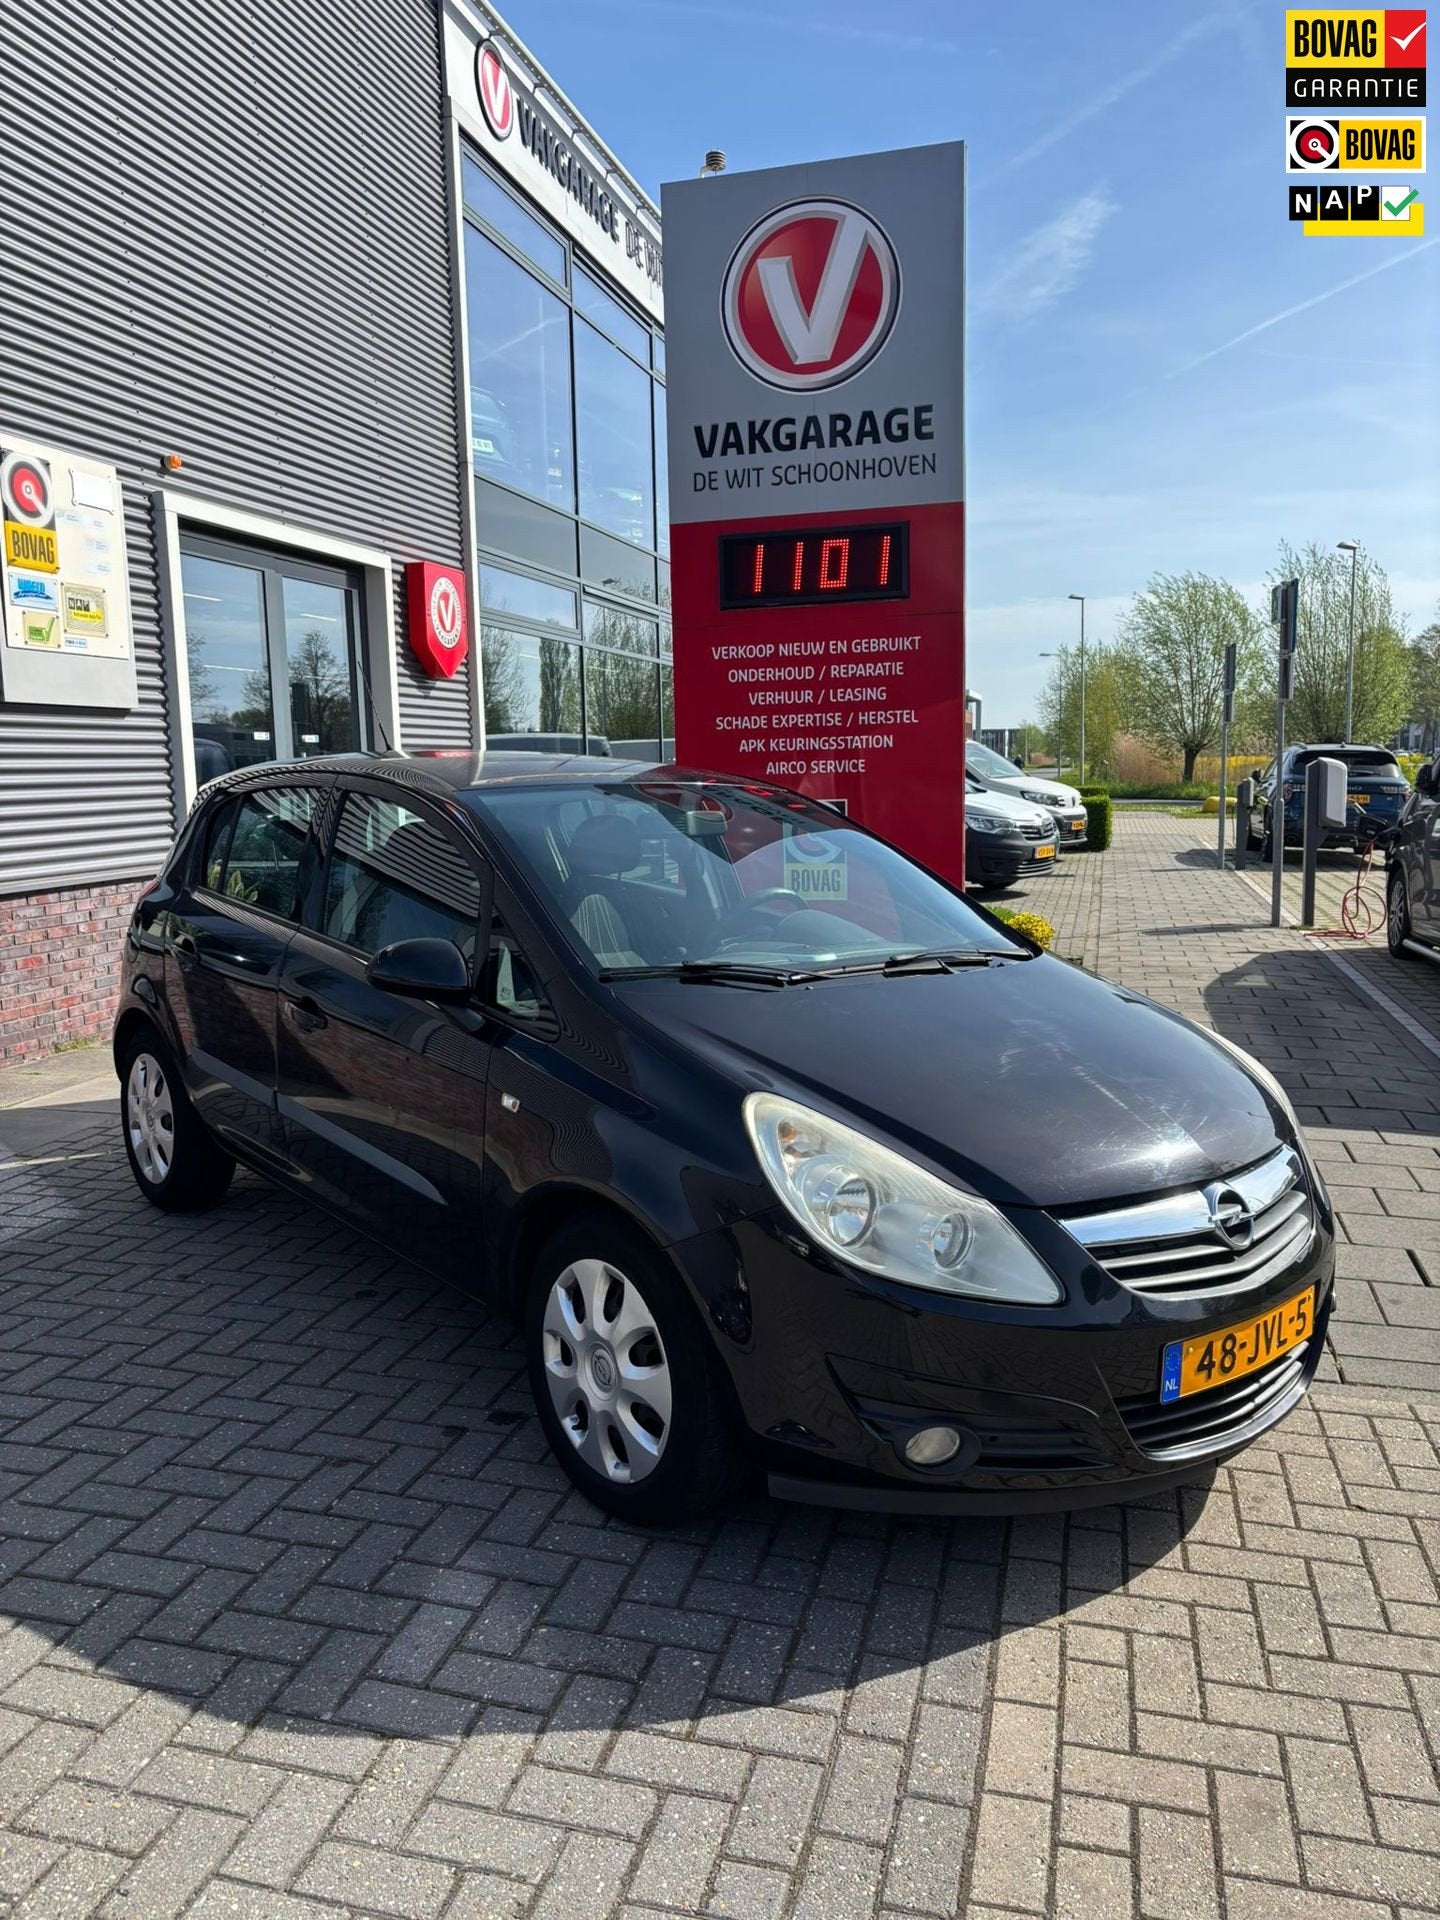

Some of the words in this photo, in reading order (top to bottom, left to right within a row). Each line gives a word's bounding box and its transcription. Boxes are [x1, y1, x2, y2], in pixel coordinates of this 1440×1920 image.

[516, 96, 620, 243] VAKGARAGE
[624, 217, 644, 270] DE
[693, 404, 936, 459] VAKGARAGE
[693, 471, 719, 492] DE
[724, 467, 765, 490] WIT
[770, 453, 937, 487] SCHOONHOVEN
[11, 530, 55, 564] BOVAG
[712, 645, 774, 659] VERKOOP
[779, 642, 824, 656] NIEUW
[829, 640, 847, 654] EN
[851, 636, 921, 653] GEBRUIKT
[728, 666, 815, 682] ONDERHOUD
[818, 665, 826, 680] /
[831, 662, 904, 677] REPARATIE
[748, 690, 814, 705] VERHUUR
[817, 690, 825, 704] /
[829, 687, 887, 701] LEASING
[716, 715, 768, 730] SCHADE
[772, 713, 842, 728] EXPERTISE
[846, 712, 854, 727] /
[858, 710, 919, 725] HERSTEL
[739, 739, 766, 753] APK
[769, 735, 893, 752] KEURINGSSTATION
[766, 760, 807, 775] AIRCO
[810, 759, 866, 774] SERVICE
[790, 868, 842, 893] BOVAG
[1197, 1296, 1307, 1380] 48-JVL-5
[1164, 1377, 1179, 1393] NL
